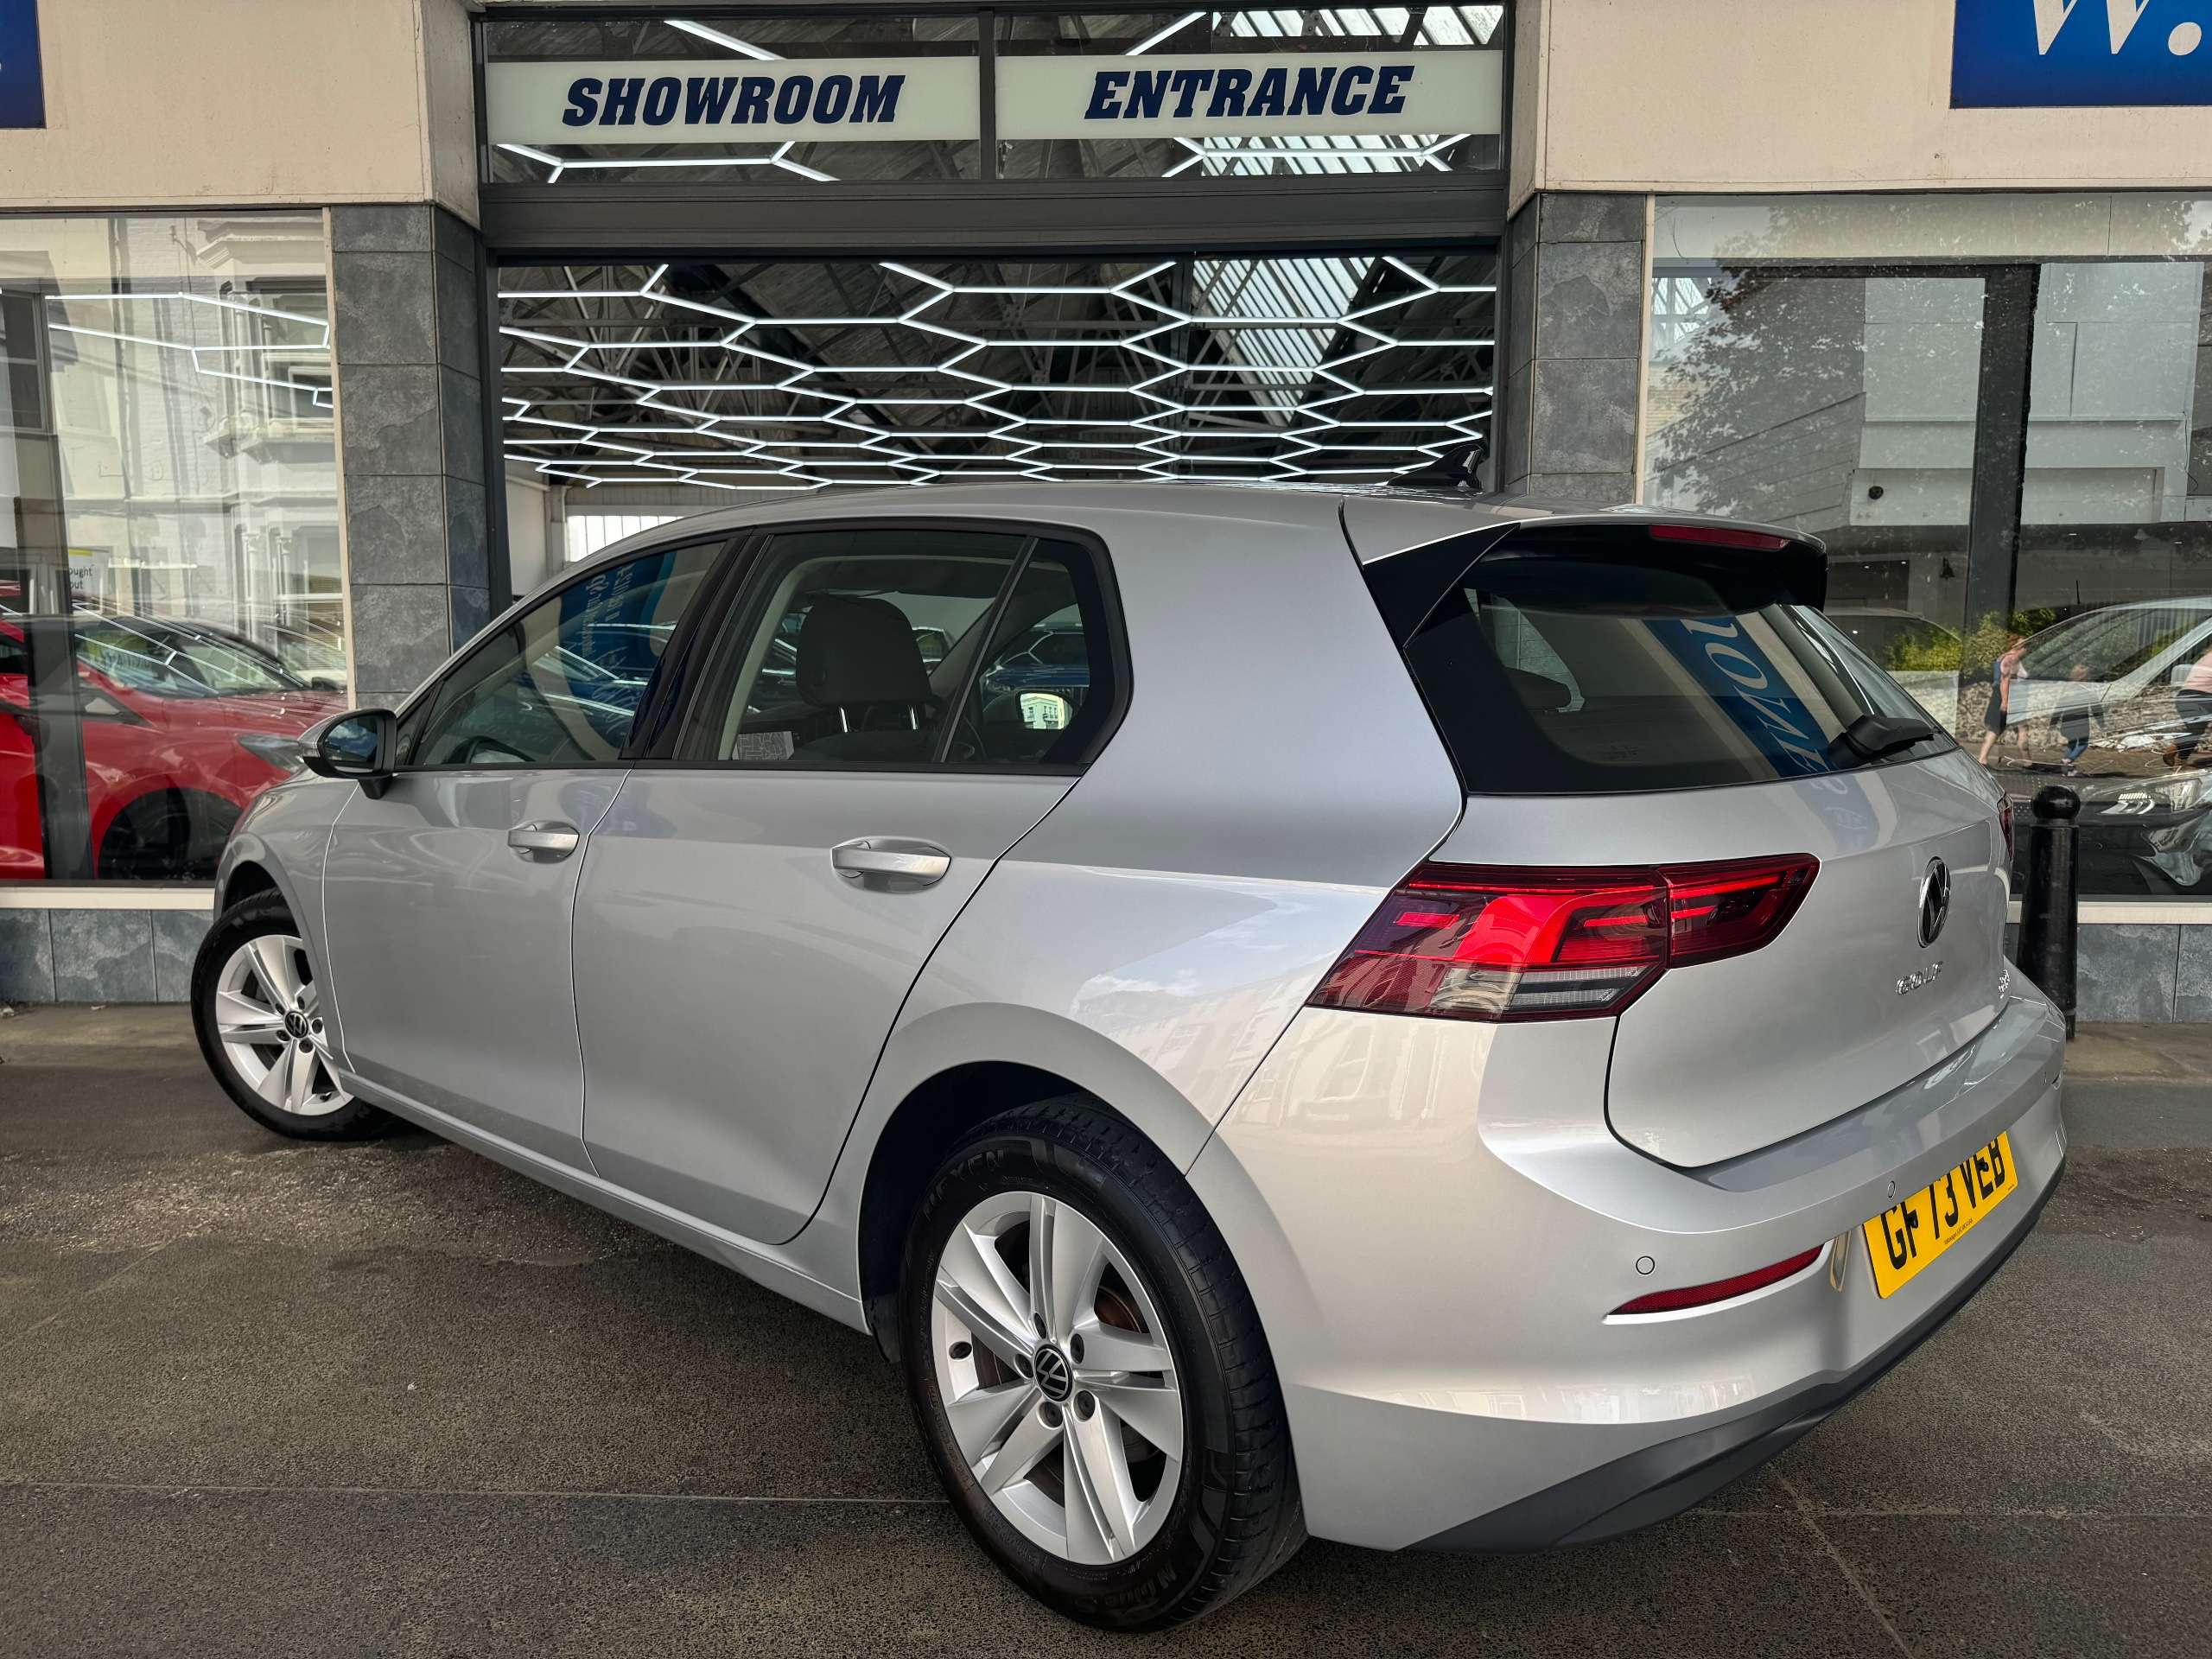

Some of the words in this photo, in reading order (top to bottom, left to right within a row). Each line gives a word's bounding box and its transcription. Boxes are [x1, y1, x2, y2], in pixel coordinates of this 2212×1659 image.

[563, 75, 906, 126] SHOWROOM
[1084, 66, 1414, 119] ENTRANCE
[1896, 961, 1943, 995] GOLF
